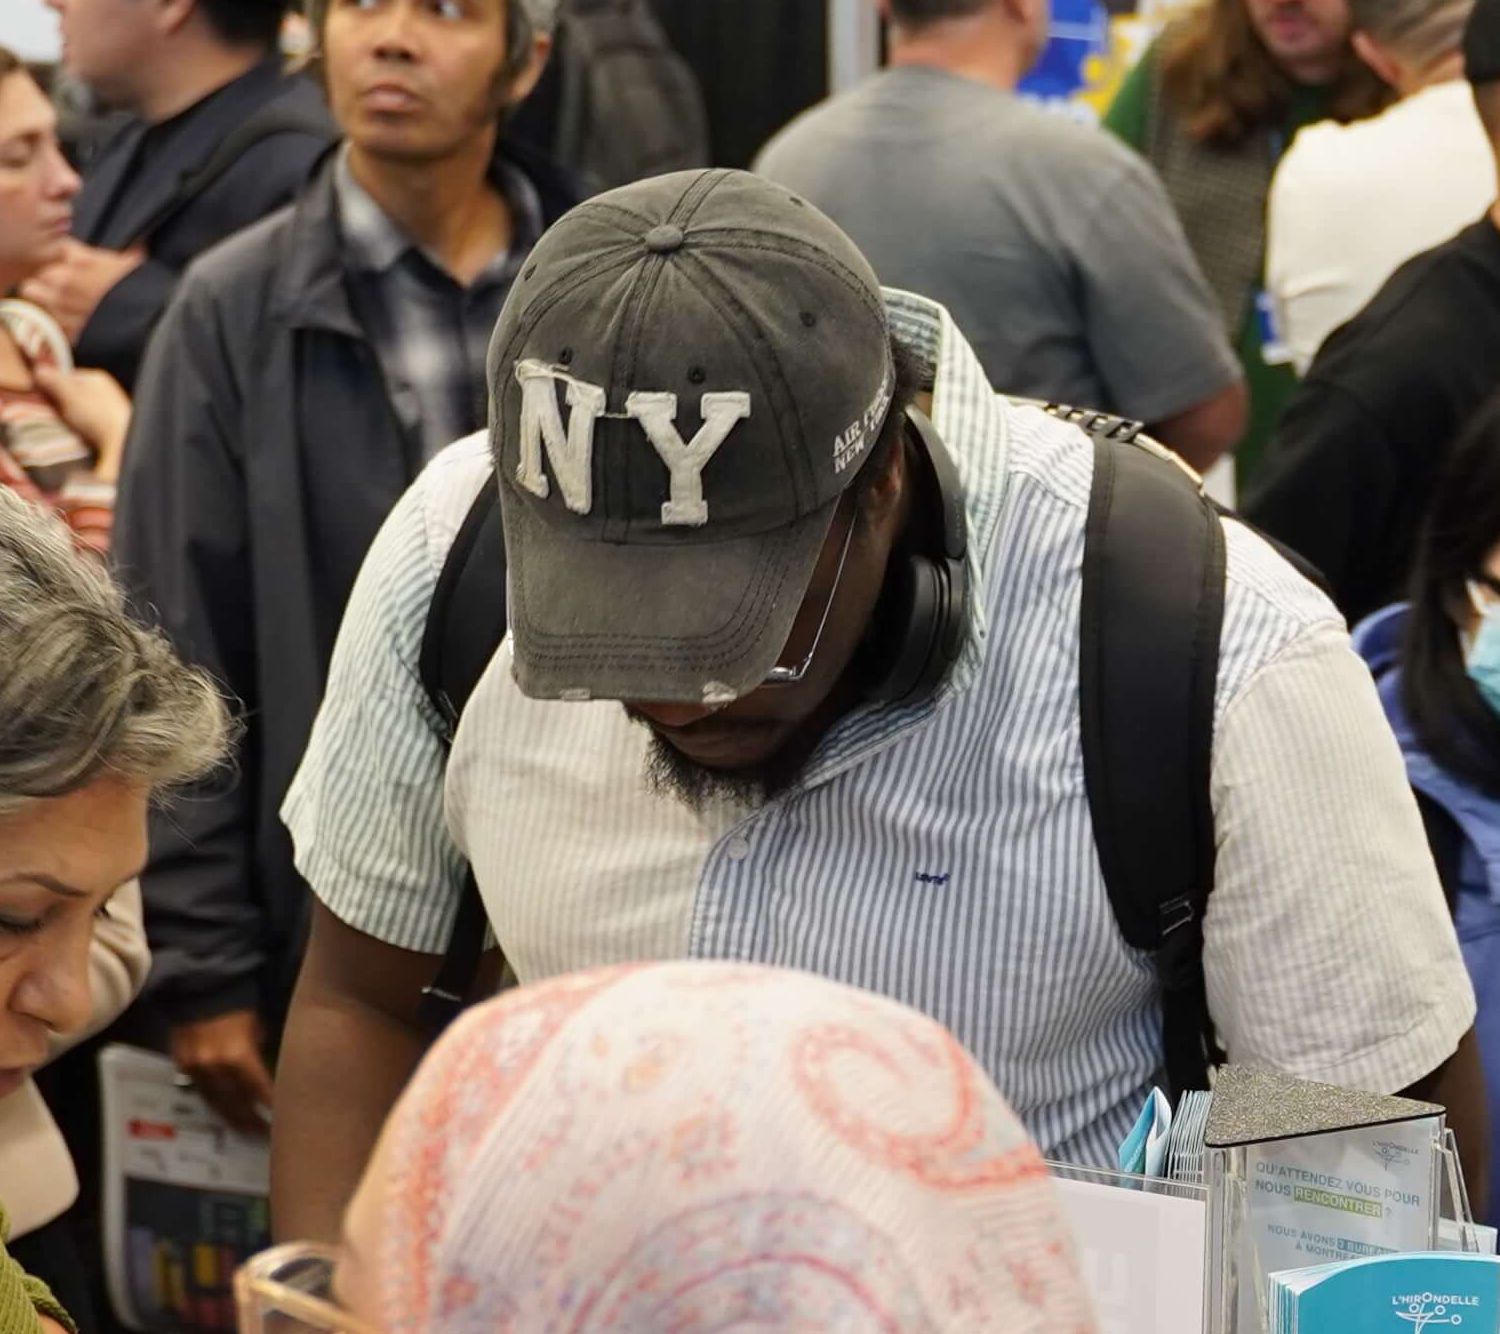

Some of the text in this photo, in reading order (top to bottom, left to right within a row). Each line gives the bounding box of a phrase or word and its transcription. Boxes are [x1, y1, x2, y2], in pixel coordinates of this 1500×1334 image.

[515, 360, 751, 525] NY
[833, 420, 862, 457] AIR
[1255, 1179, 1291, 1196] NOUS
[1295, 1186, 1381, 1217] RENCONTRER
[1256, 1161, 1420, 1207] QU'ATTENDEZ VOUS POUR
[1268, 1224, 1336, 1248] NOUS AVONS
[1392, 1291, 1479, 1306] L'HIRONDELLE
